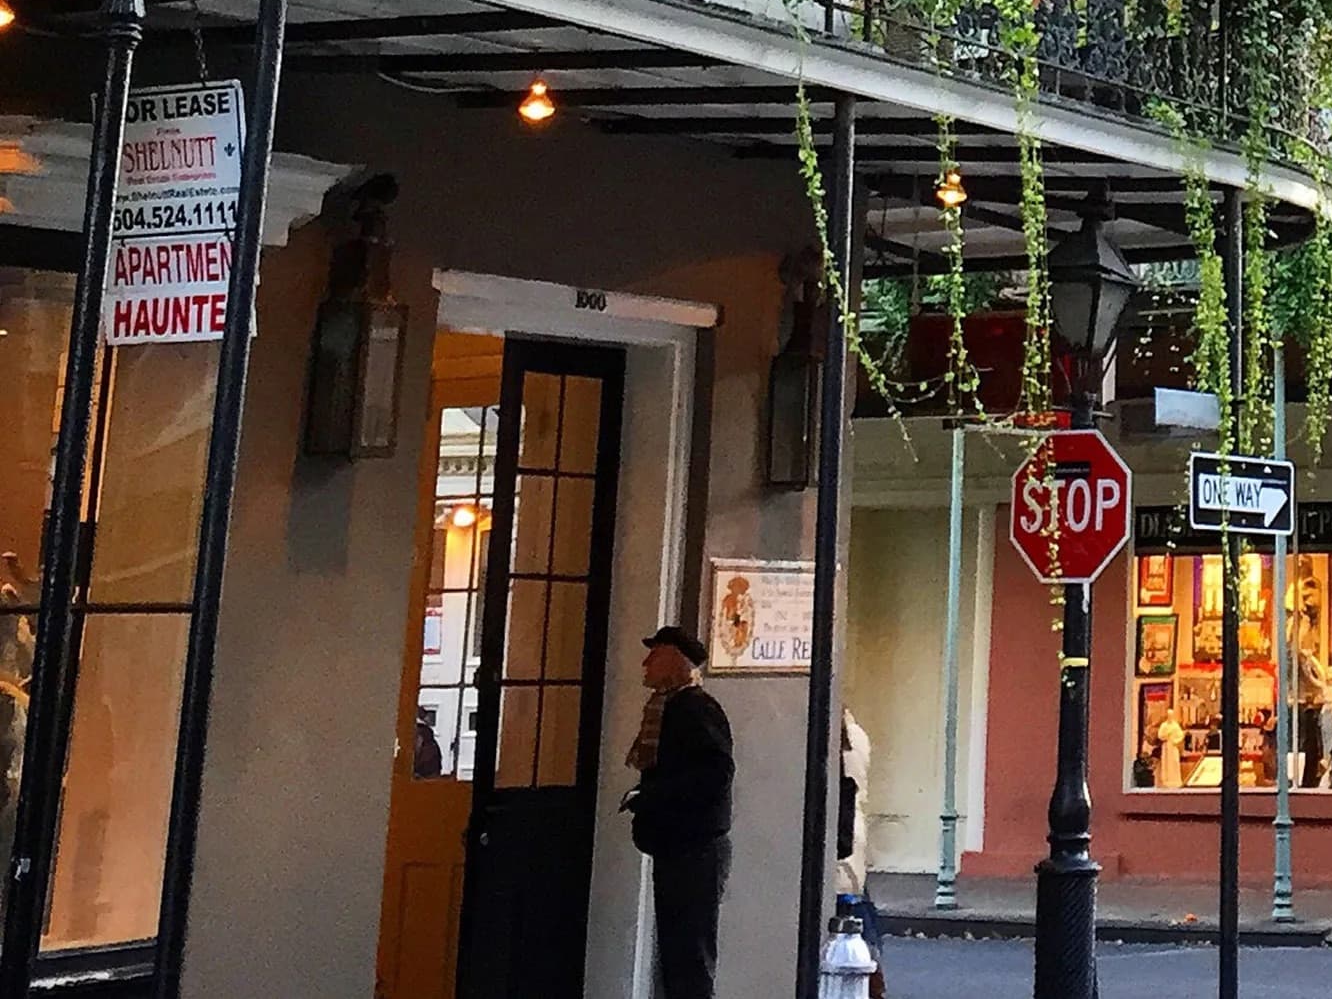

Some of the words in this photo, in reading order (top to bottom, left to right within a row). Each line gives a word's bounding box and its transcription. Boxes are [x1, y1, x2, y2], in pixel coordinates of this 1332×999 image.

[125, 99, 157, 123] OR
[163, 92, 230, 119] LEASE
[122, 136, 216, 172] SHELNUTT
[113, 242, 231, 287] APARTMEN
[113, 294, 226, 339] HAUNTE
[1020, 478, 1121, 534] STOP
[1203, 478, 1231, 506] ONE
[1235, 480, 1262, 508] WAY
[792, 637, 811, 660] RE
